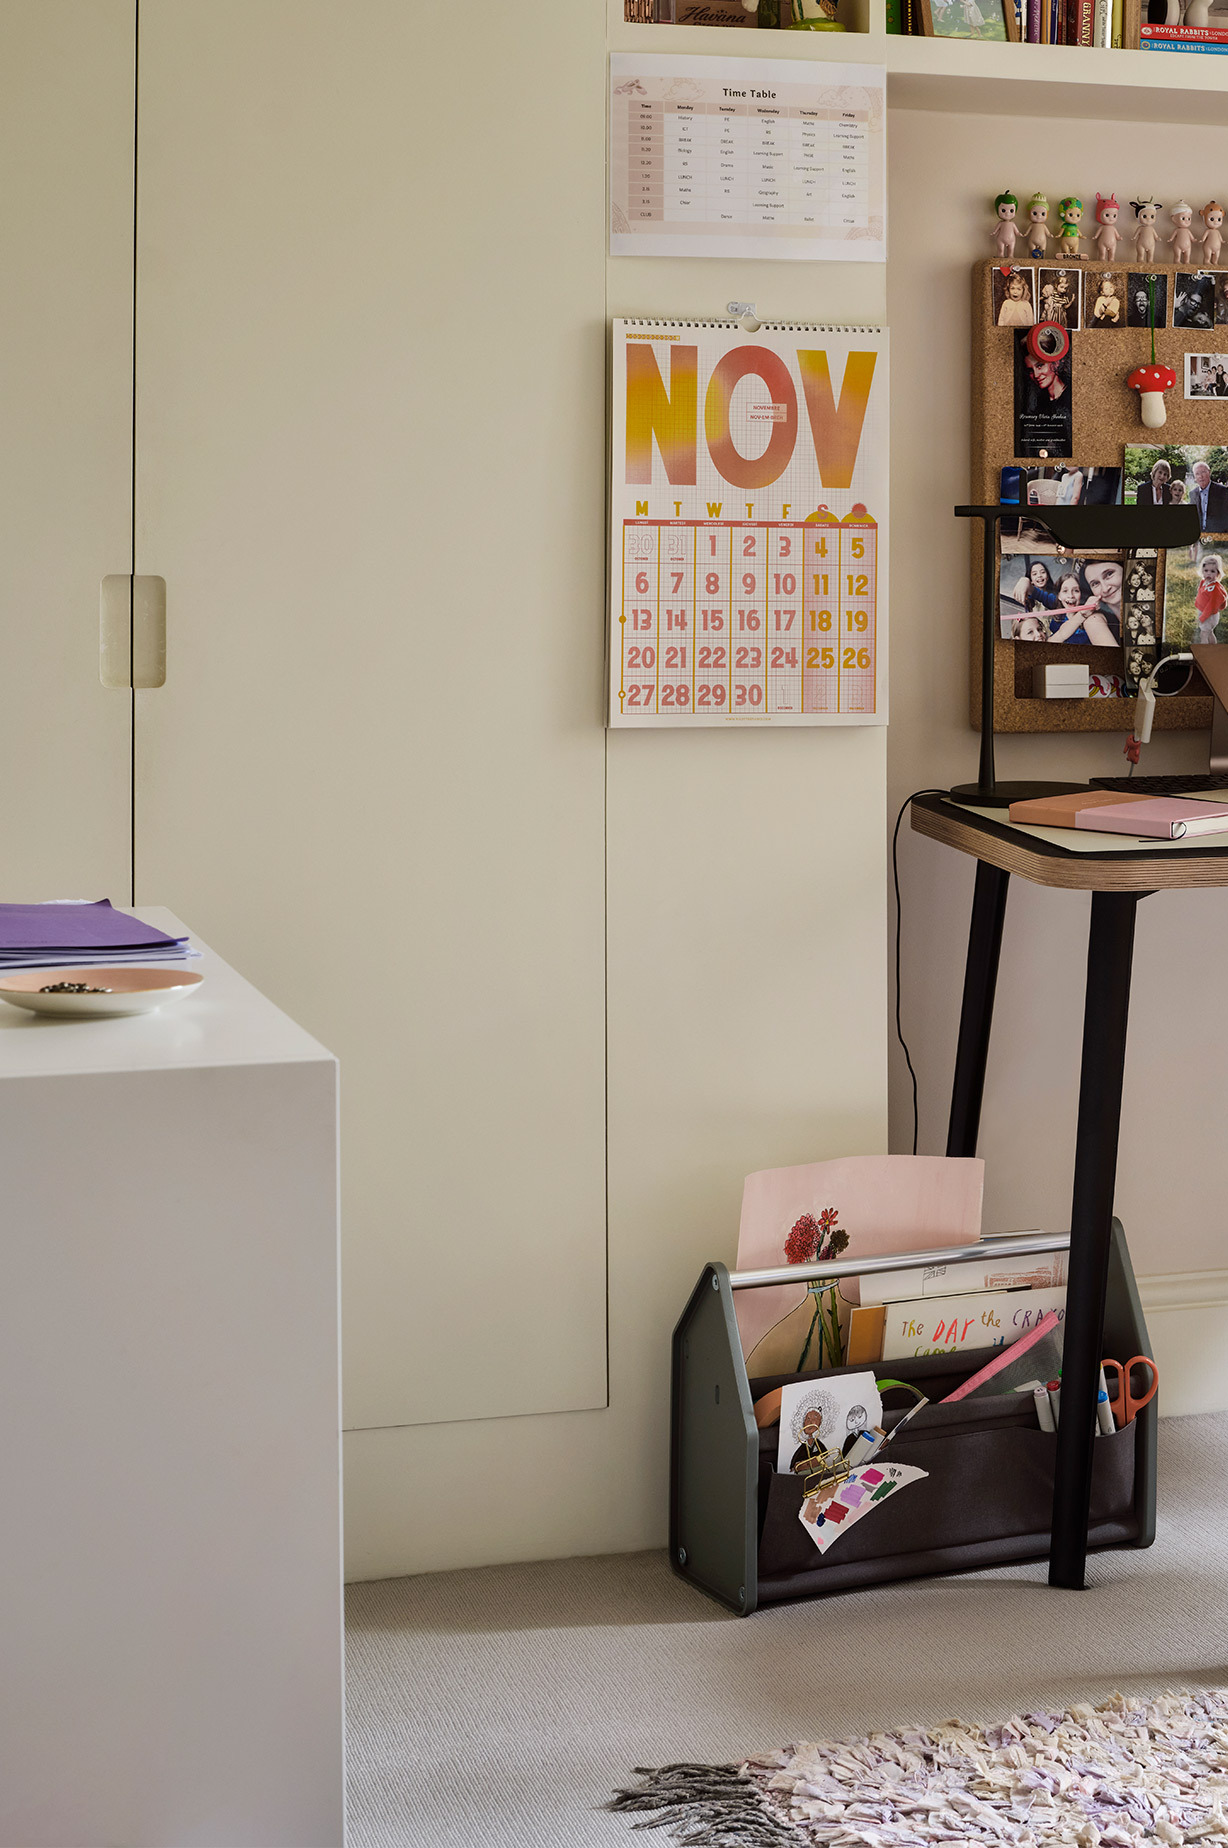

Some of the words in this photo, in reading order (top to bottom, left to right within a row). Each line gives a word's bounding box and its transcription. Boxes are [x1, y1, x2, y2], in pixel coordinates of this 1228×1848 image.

[1082, 2, 1092, 47] GRANNY
[1180, 28, 1209, 36] RABBITS
[1153, 42, 1175, 50] ROYAL
[1177, 43, 1205, 52] RABBITS
[723, 88, 747, 98] Time
[750, 89, 777, 99] Table
[625, 343, 878, 490] NOV
[636, 500, 648, 516] M
[673, 501, 682, 517] T
[706, 502, 723, 518] W
[745, 503, 754, 519] T
[782, 504, 791, 519] F
[817, 504, 829, 520] S
[628, 534, 654, 555] 30
[709, 535, 716, 557] 1
[743, 535, 756, 557] 2
[779, 536, 791, 558] 3
[815, 537, 828, 558] 4
[851, 537, 865, 559] 5
[635, 571, 649, 594] 6
[670, 571, 684, 594] 7
[705, 571, 720, 594] 8
[742, 572, 756, 595] 9
[773, 572, 797, 595] 10
[812, 573, 829, 596] 11
[846, 573, 869, 596] 12
[632, 609, 652, 631] 13
[665, 609, 688, 631] 14
[701, 609, 724, 631] 15
[737, 609, 761, 631] 16
[774, 609, 796, 631] 17
[809, 610, 832, 632] 18
[845, 610, 869, 632] 19
[627, 646, 656, 669] 20
[665, 646, 686, 669] 21
[698, 646, 726, 669] 22
[735, 646, 762, 669] 23
[770, 646, 798, 669] 24
[806, 646, 835, 669] 25
[842, 646, 871, 669] 26
[627, 684, 655, 706] 27
[661, 684, 690, 706] 28
[697, 684, 726, 706] 29
[735, 684, 763, 706] 30
[902, 1319, 925, 1338] The
[932, 1317, 976, 1344] DAY
[981, 1309, 1001, 1328] the
[1012, 1308, 1066, 1329] CRAO
